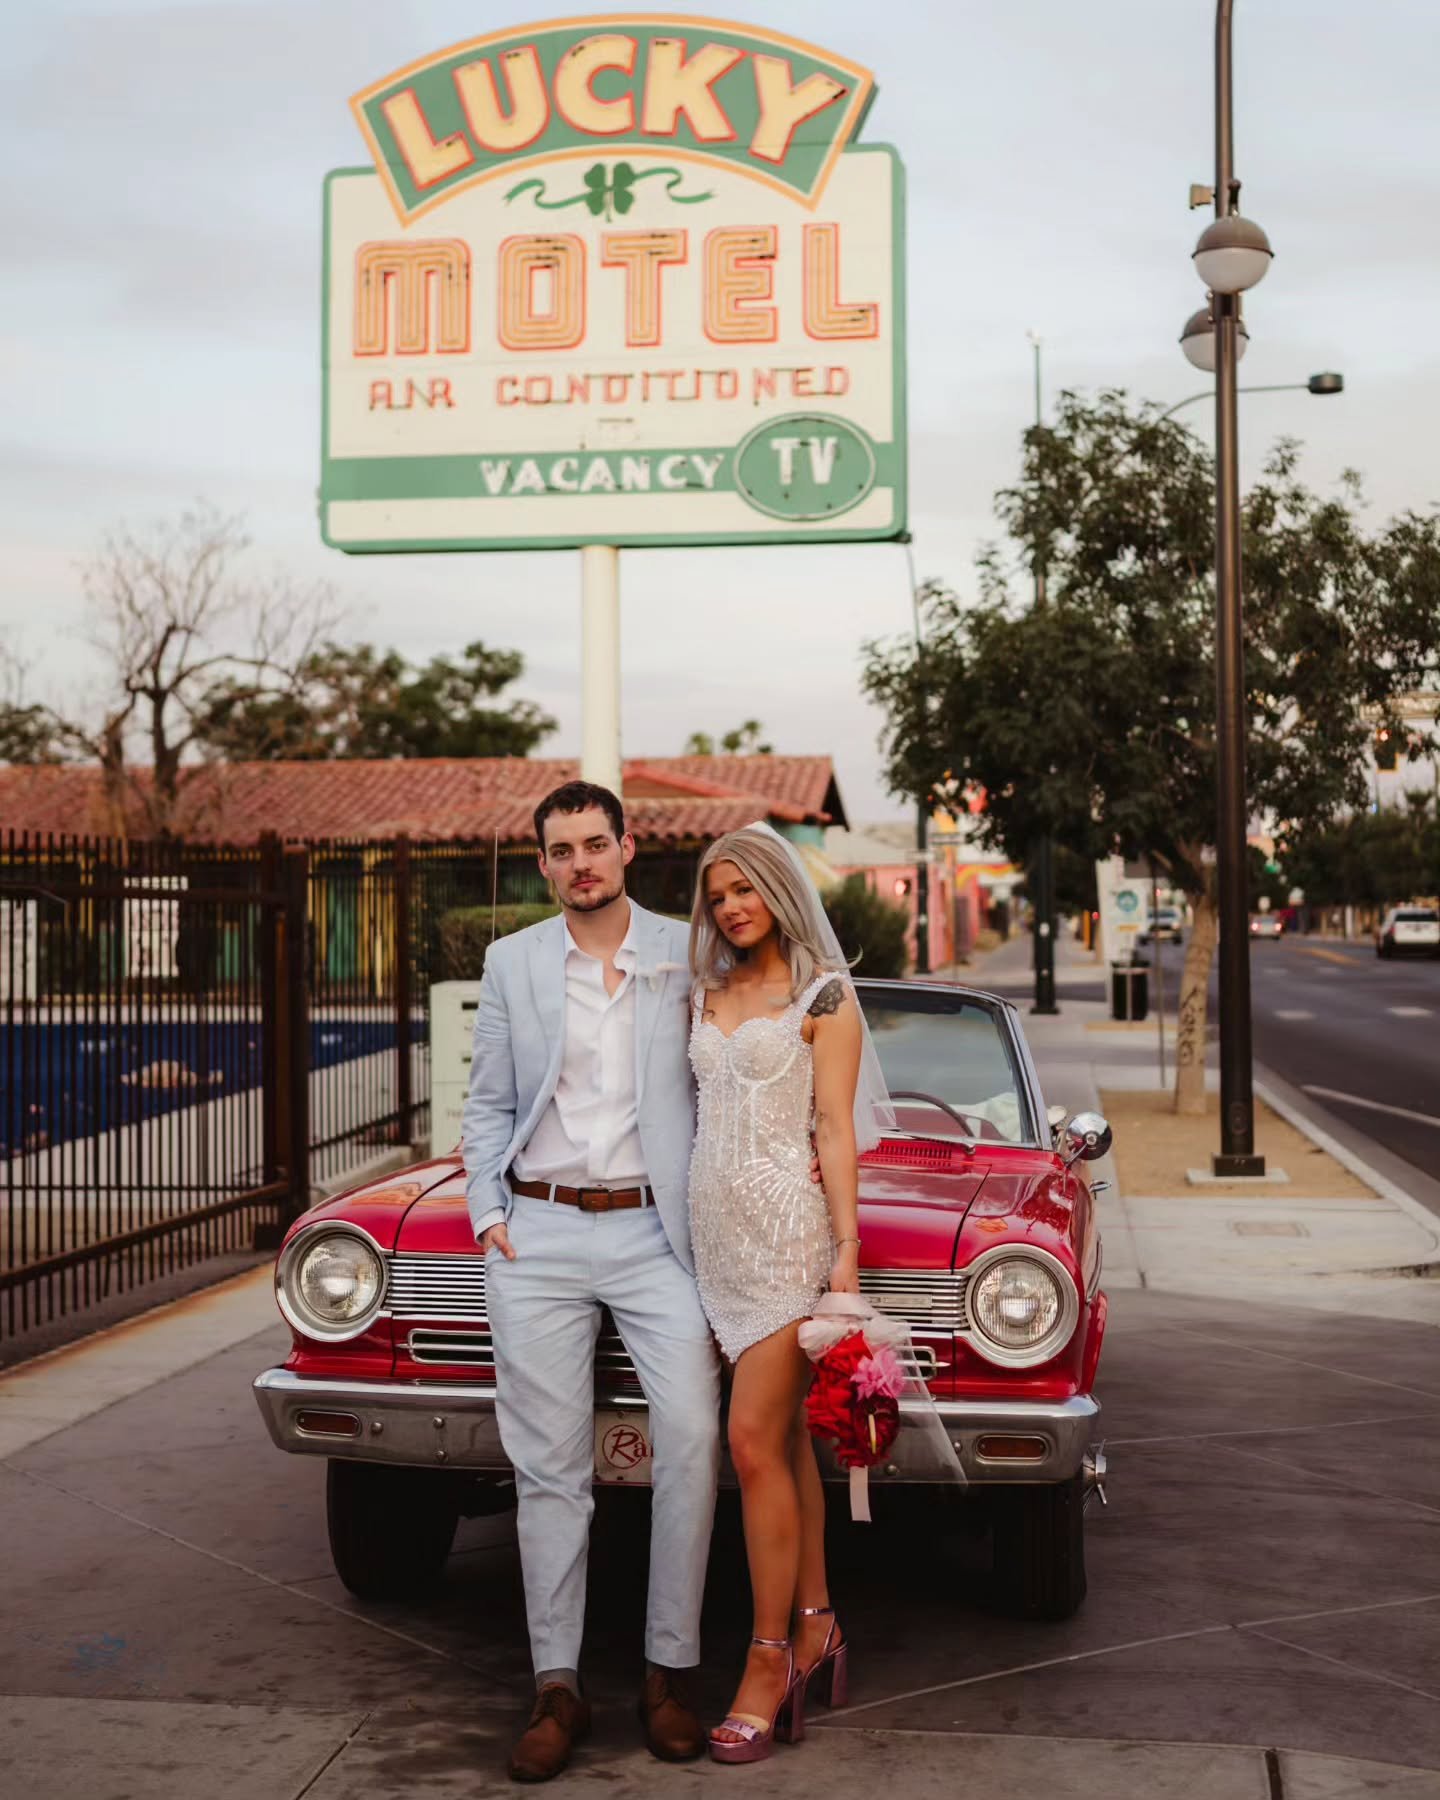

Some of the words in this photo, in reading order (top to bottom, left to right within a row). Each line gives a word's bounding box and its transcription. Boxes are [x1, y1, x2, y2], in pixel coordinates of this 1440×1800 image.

[380, 33, 848, 192] LUCKY
[353, 222, 879, 356] MOTEL
[370, 376, 454, 410] AIR
[495, 366, 851, 406] CONDITIONED
[479, 454, 725, 496] VACANCY
[770, 435, 838, 485] TV
